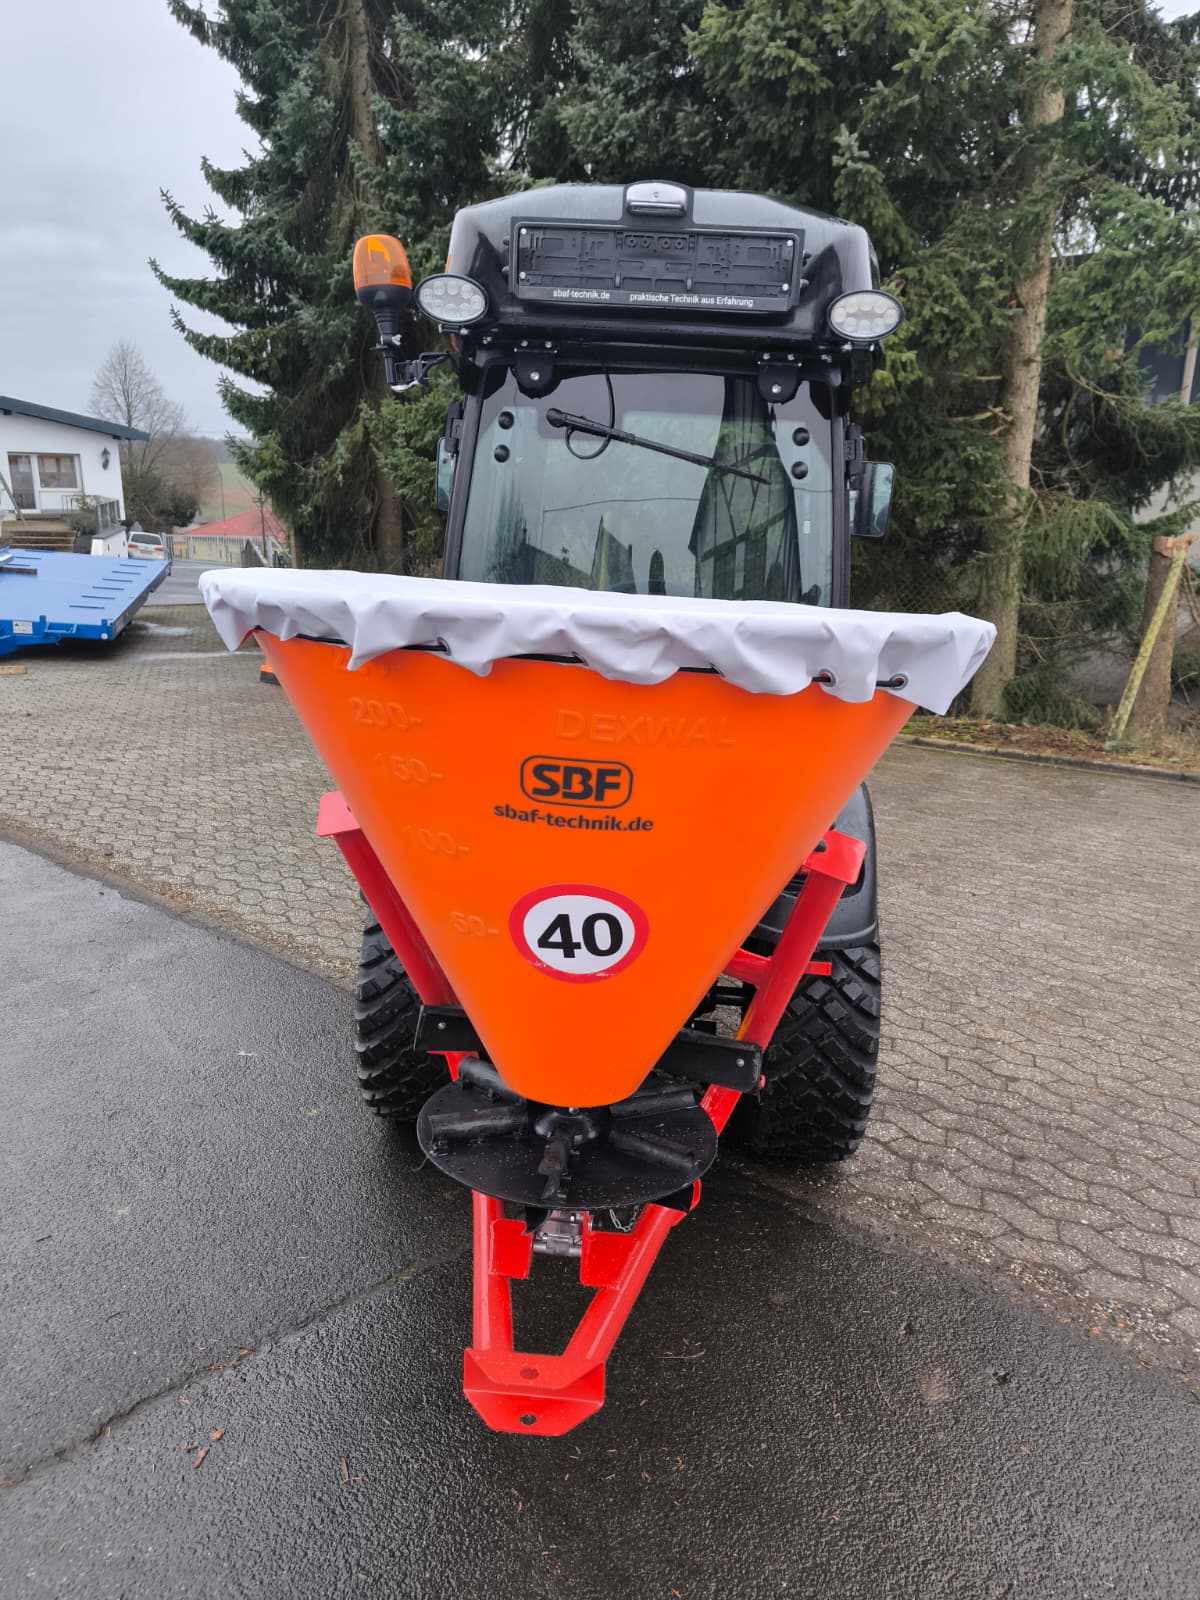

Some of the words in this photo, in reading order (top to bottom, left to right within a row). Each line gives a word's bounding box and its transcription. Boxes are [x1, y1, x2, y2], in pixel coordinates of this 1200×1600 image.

[553, 288, 611, 300] sbaf-technik.de
[629, 292, 669, 303] praktische
[670, 293, 700, 304] Technik
[701, 297, 715, 305] aus
[716, 296, 754, 308] Erfahrung
[555, 709, 737, 746] DEXWAL
[531, 763, 622, 802] SBF
[493, 803, 654, 832] sbaf-technik.de
[536, 912, 625, 959] 40
